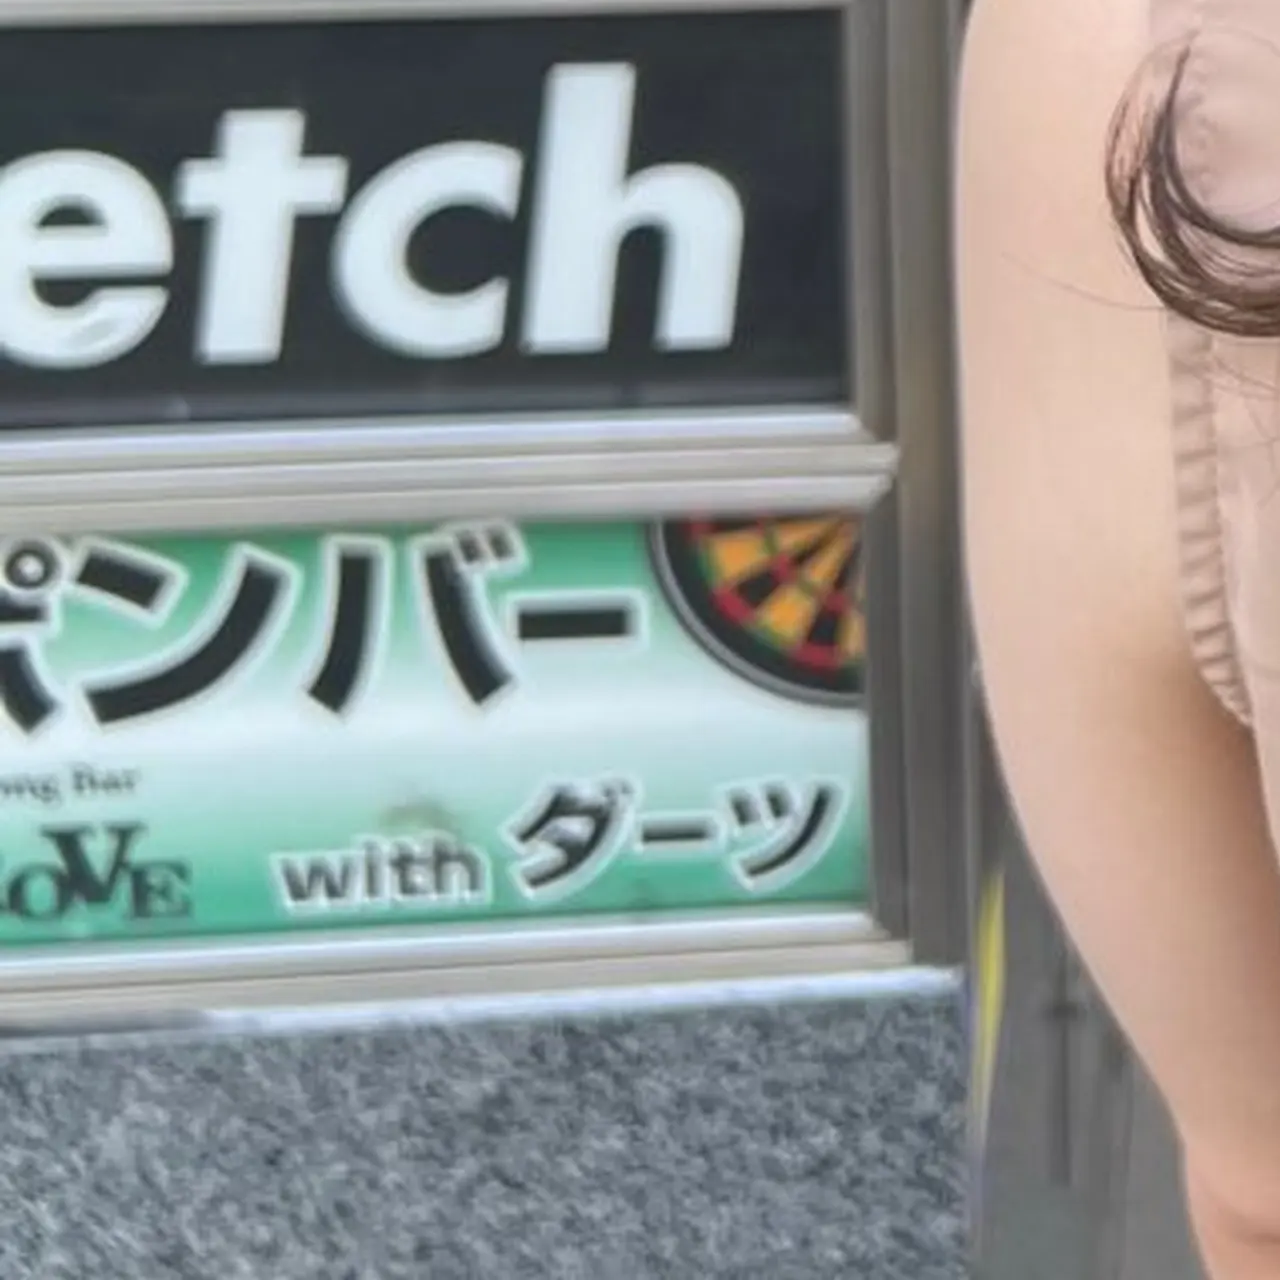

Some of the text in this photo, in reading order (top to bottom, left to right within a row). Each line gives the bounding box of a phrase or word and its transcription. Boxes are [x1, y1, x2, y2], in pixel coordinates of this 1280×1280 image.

[0, 62, 744, 368] etch
[0, 821, 194, 922] OVE
[280, 782, 838, 904] with ダーツ
